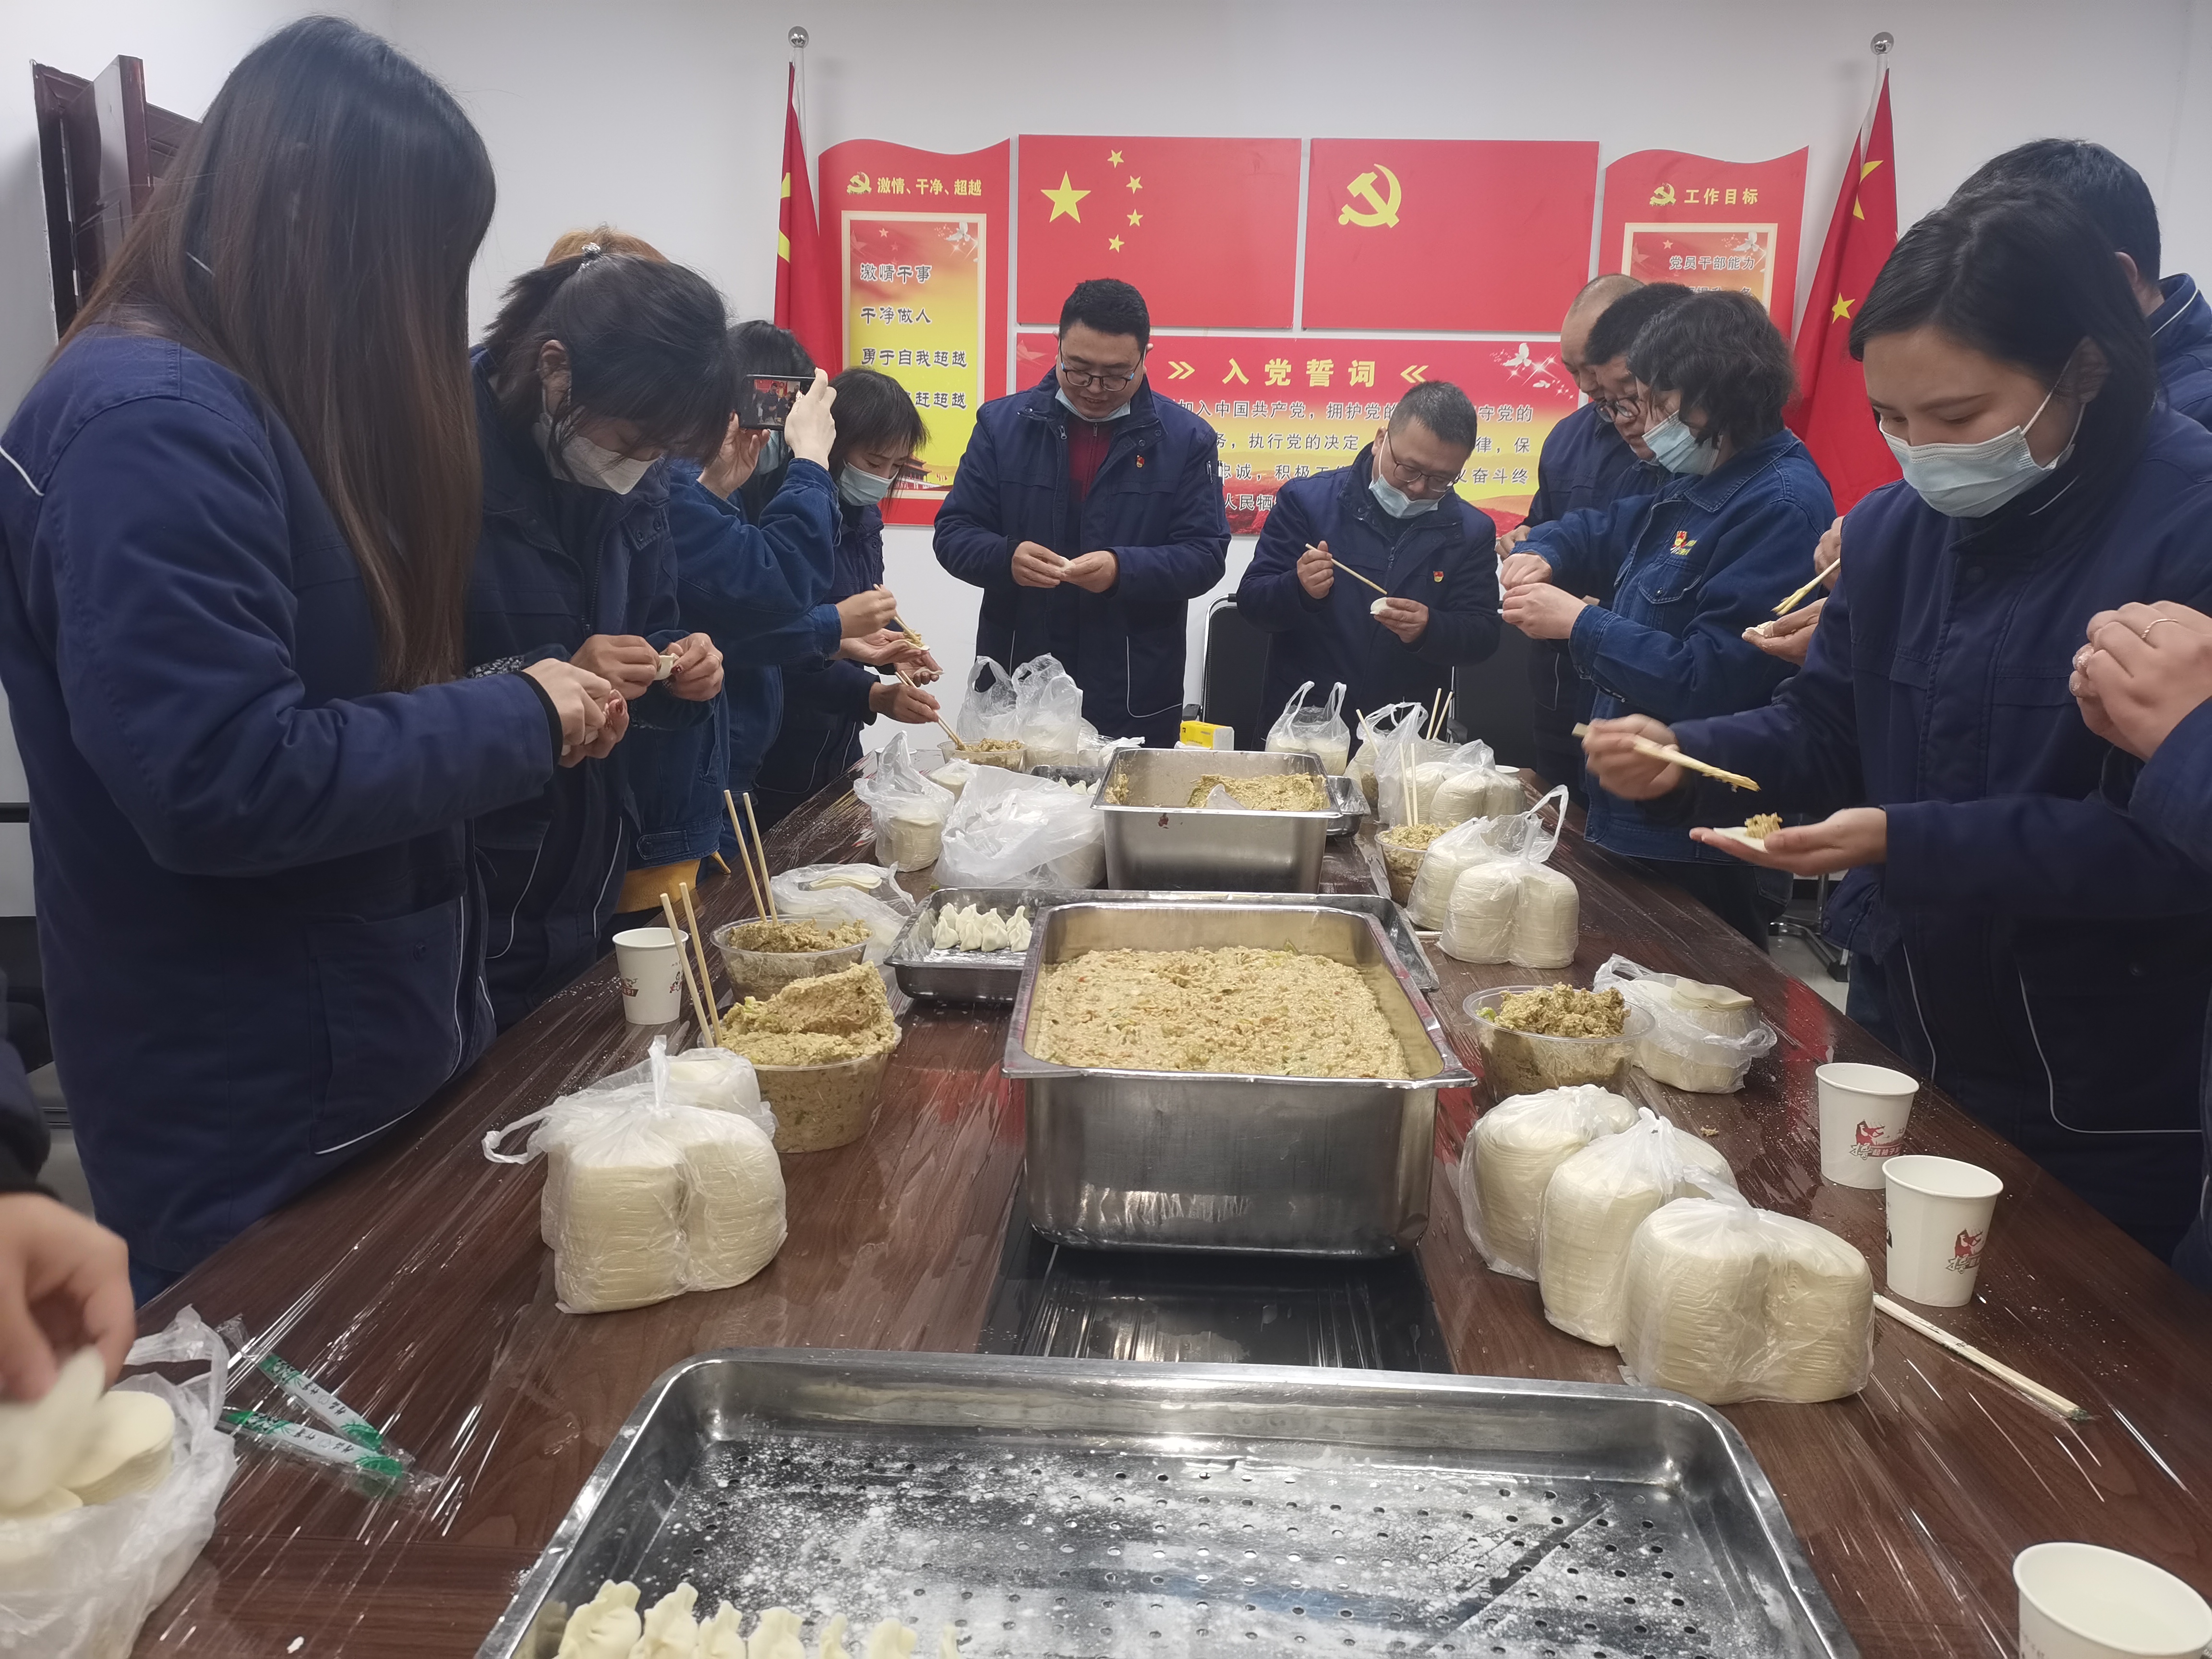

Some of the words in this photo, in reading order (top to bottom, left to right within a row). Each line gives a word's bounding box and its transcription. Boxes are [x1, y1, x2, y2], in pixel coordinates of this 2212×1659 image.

[878, 178, 982, 196] 激情、干净、超越
[1684, 188, 1758, 205] 工作目标
[1670, 256, 1755, 270] 党员干部能力
[861, 264, 931, 283] 激情干事
[861, 308, 931, 325] 干净做人
[862, 349, 967, 368] 勇于自我超越
[1222, 359, 1375, 387] 入党誓词
[906, 391, 967, 409] 赶超越
[1225, 494, 1276, 511] 人民牺
